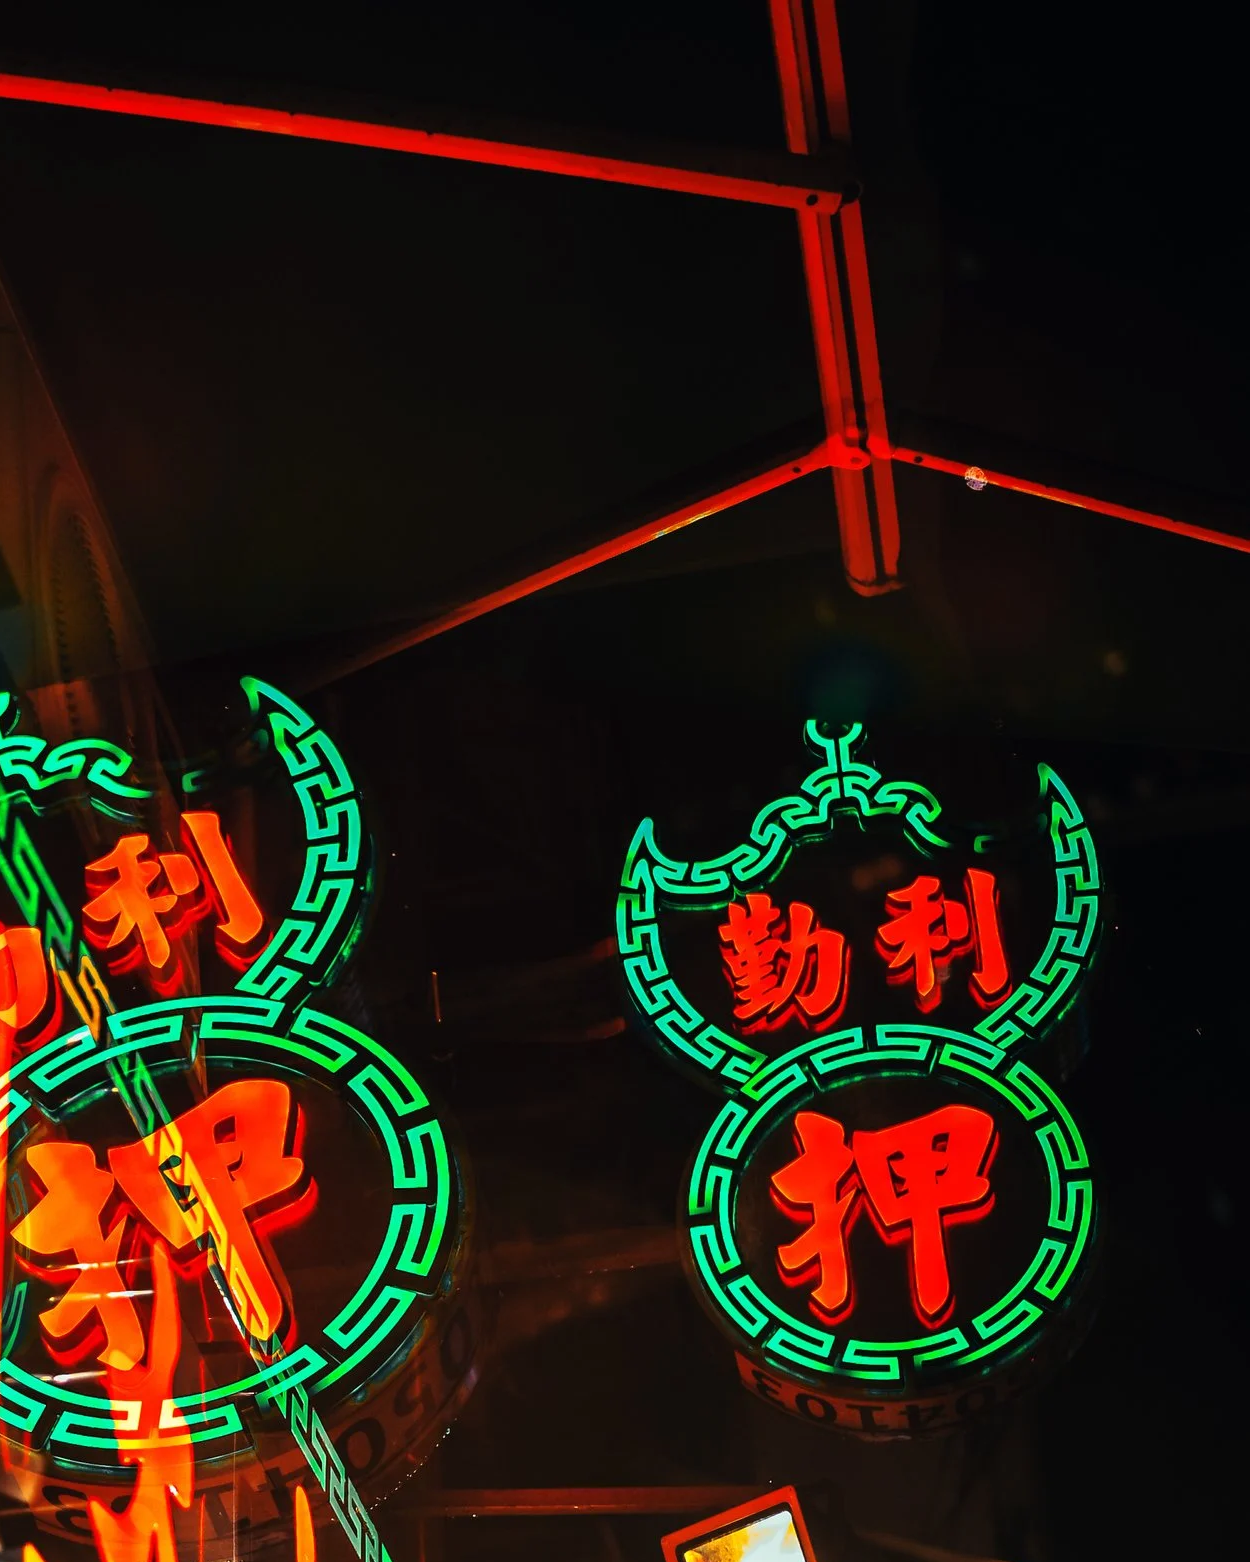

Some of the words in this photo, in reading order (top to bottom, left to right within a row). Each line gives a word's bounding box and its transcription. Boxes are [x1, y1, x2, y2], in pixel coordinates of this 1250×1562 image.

[719, 868, 1010, 1025] 勤利
[10, 1079, 308, 1370] 押
[770, 1104, 999, 1322] 押
